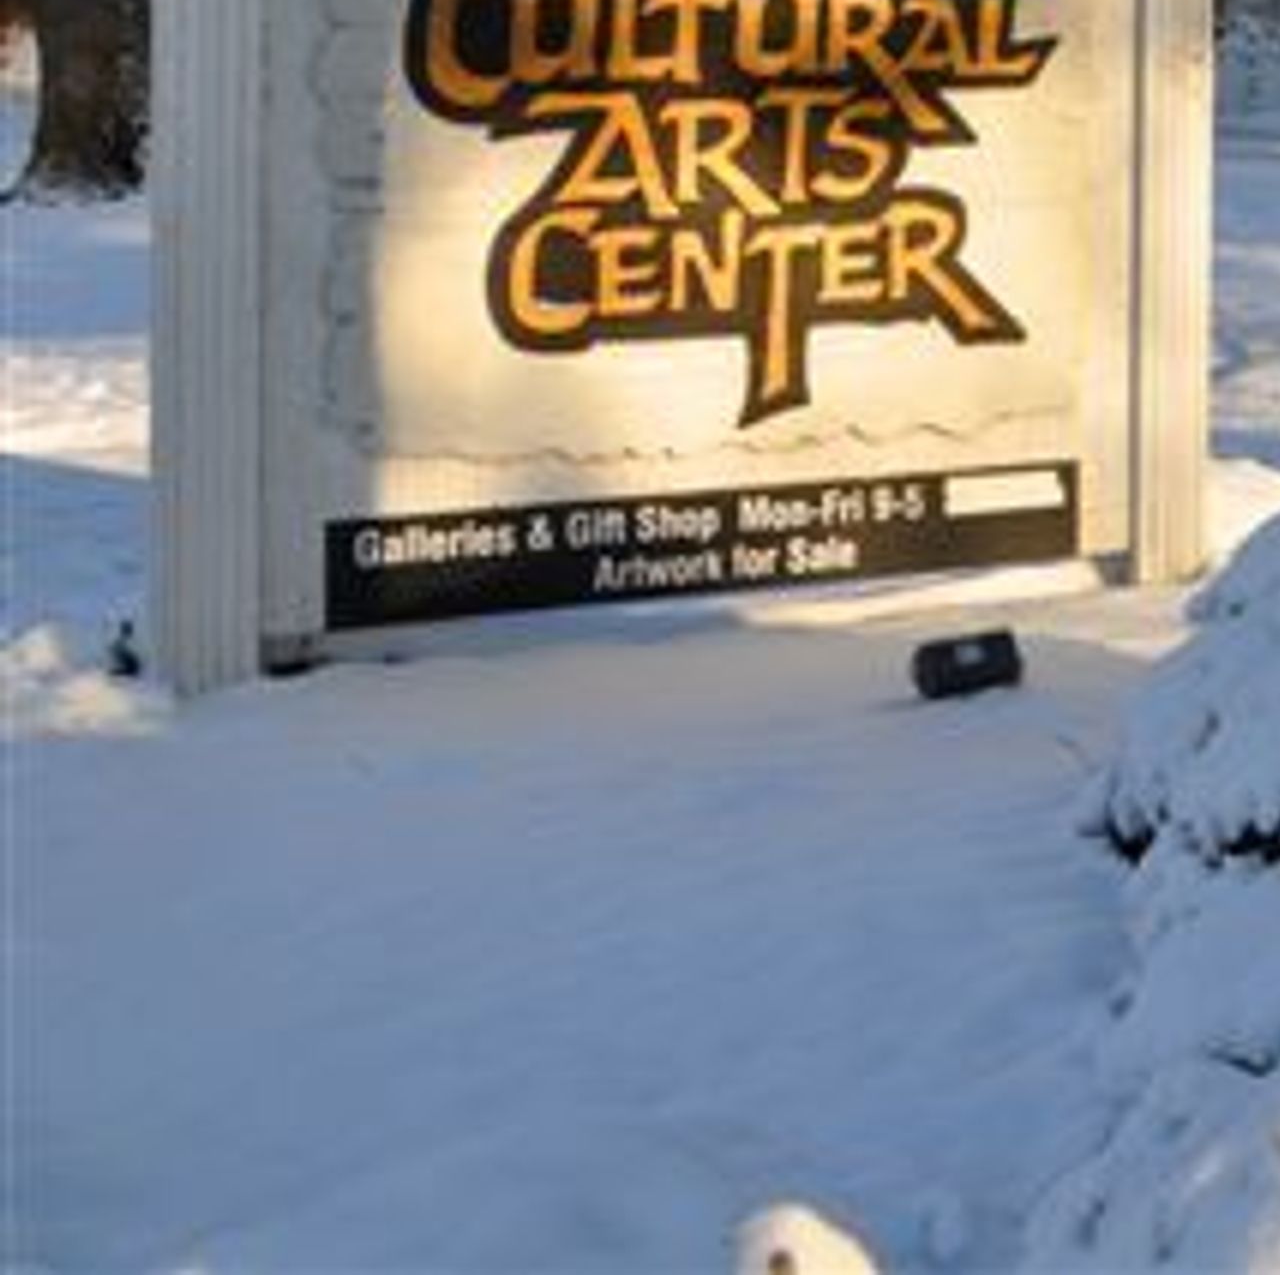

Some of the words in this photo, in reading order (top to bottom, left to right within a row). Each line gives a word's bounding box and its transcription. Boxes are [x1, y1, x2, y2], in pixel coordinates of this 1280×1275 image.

[527, 88, 902, 219] ARTS
[492, 191, 1024, 423] CENTER
[353, 518, 517, 570] Galleries
[526, 512, 562, 552] &
[564, 507, 627, 551] Gift
[635, 500, 722, 543] Shop
[735, 487, 866, 532] Mon-Fri
[869, 482, 926, 522] 9-5
[594, 551, 722, 593] Artwork
[732, 543, 778, 580] for
[785, 535, 859, 575] Sale
